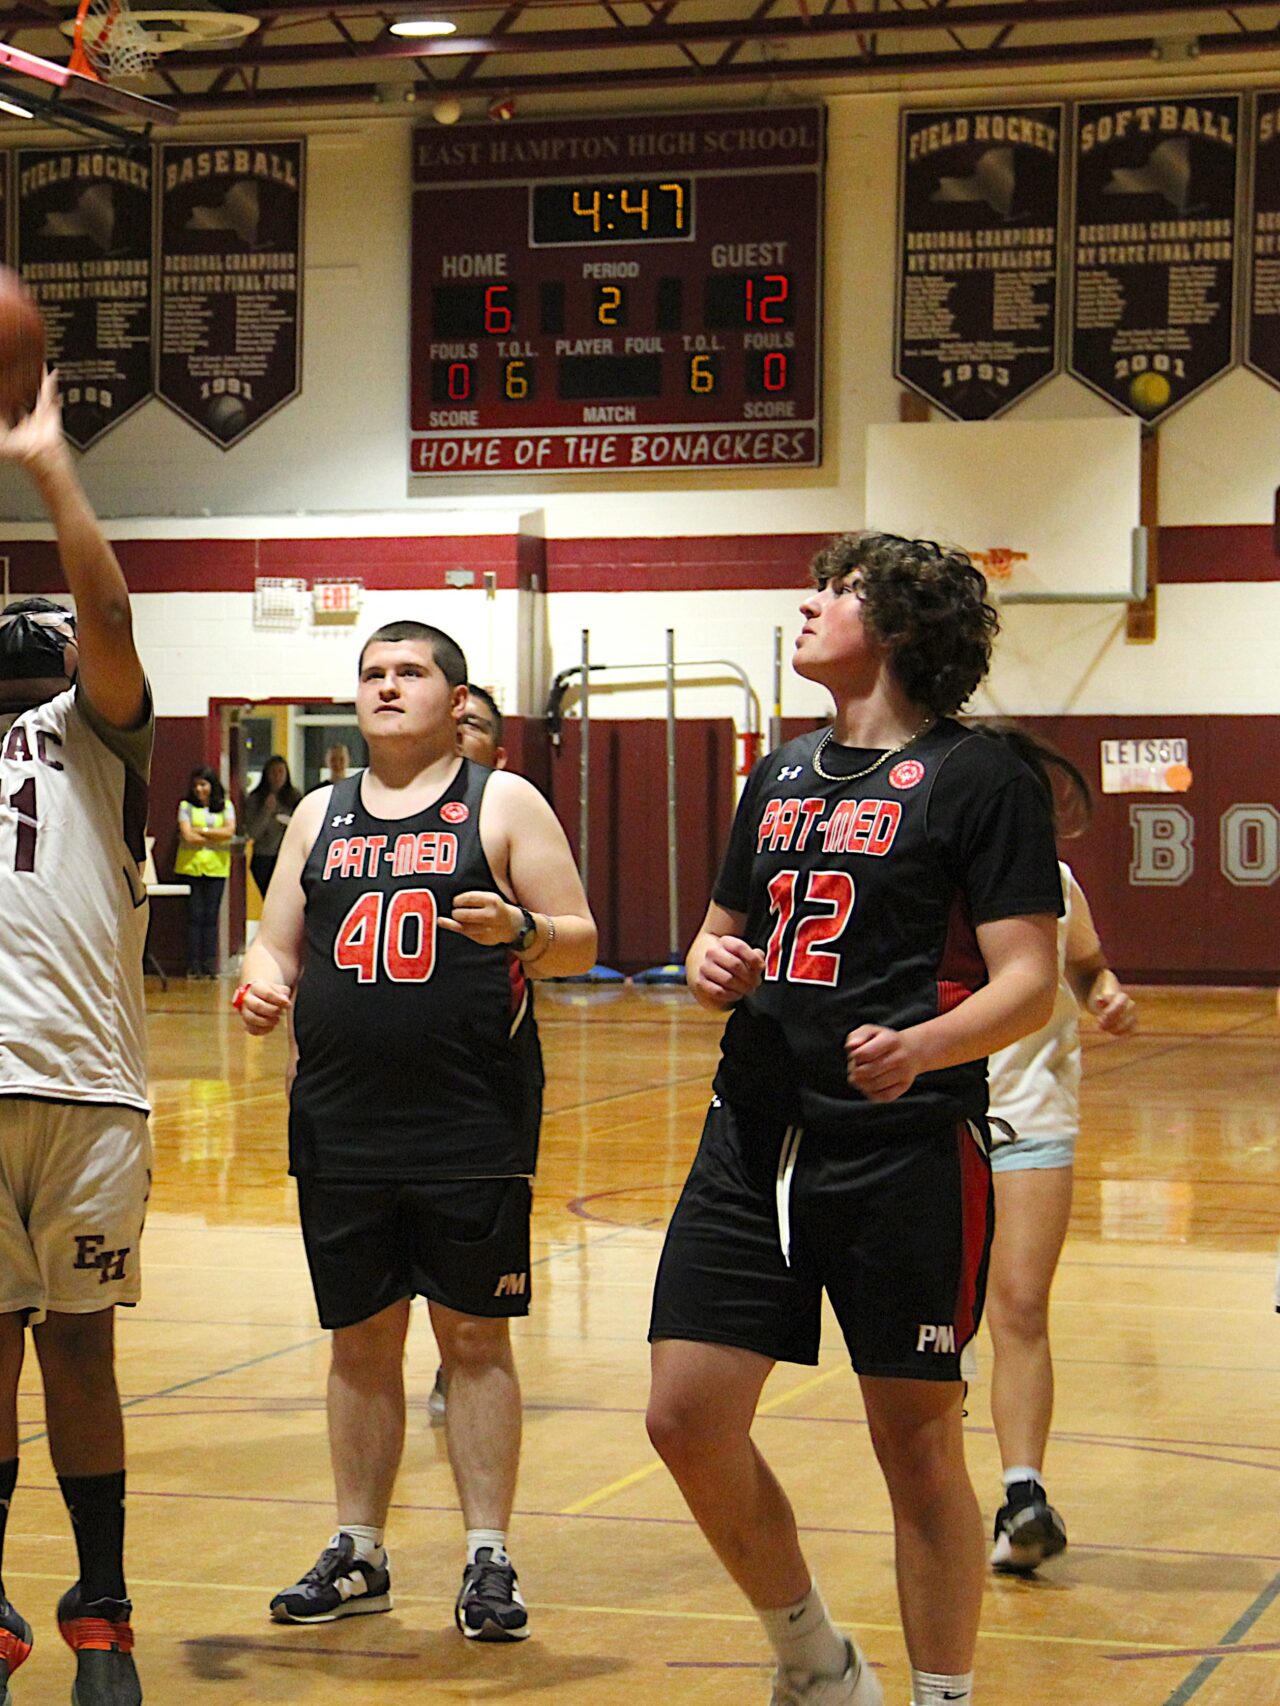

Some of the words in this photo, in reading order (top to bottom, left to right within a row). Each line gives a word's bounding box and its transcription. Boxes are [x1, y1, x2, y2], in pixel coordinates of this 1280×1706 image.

[418, 143, 482, 166] EAST
[491, 136, 620, 163] HAMPTON
[628, 132, 696, 157] HIGH
[703, 126, 817, 153] SCHOOL
[909, 116, 969, 160] FIELD
[974, 115, 1057, 154] HOCKEY
[1080, 105, 1234, 152] SOFTBALL
[21, 156, 72, 197] FIELD
[77, 153, 149, 191] HOCKEY
[165, 149, 297, 192] BASEBALL
[573, 184, 684, 233] 4:47
[441, 253, 508, 278] HOME
[583, 261, 641, 284] PERIOD
[710, 241, 788, 269] GUEST
[485, 286, 512, 334] 6
[597, 286, 621, 325] 2
[745, 275, 789, 324] 12
[429, 343, 479, 360] FOULS
[497, 341, 539, 358] T.O.L.
[556, 340, 614, 357] PLAYER
[625, 337, 664, 354] FOUL
[683, 335, 725, 352] T.O.L.
[743, 332, 796, 350] FOULS
[448, 363, 470, 400] 0
[505, 361, 528, 399] 6
[690, 355, 714, 392] 6
[763, 352, 787, 391] 0
[428, 409, 479, 427] SCORE
[582, 406, 637, 423] MATCH
[743, 401, 796, 419] SCORE
[418, 438, 503, 467] HOME
[515, 438, 553, 465] OF
[563, 436, 618, 463] THE
[629, 432, 806, 462] BONACKERS
[756, 797, 902, 857] PAT-MED
[322, 831, 459, 881] PAT-MED
[333, 888, 438, 984] 40
[765, 869, 856, 988] 12
[73, 1234, 131, 1286] EH
[493, 1272, 527, 1298] PM
[915, 1324, 957, 1354] PM
